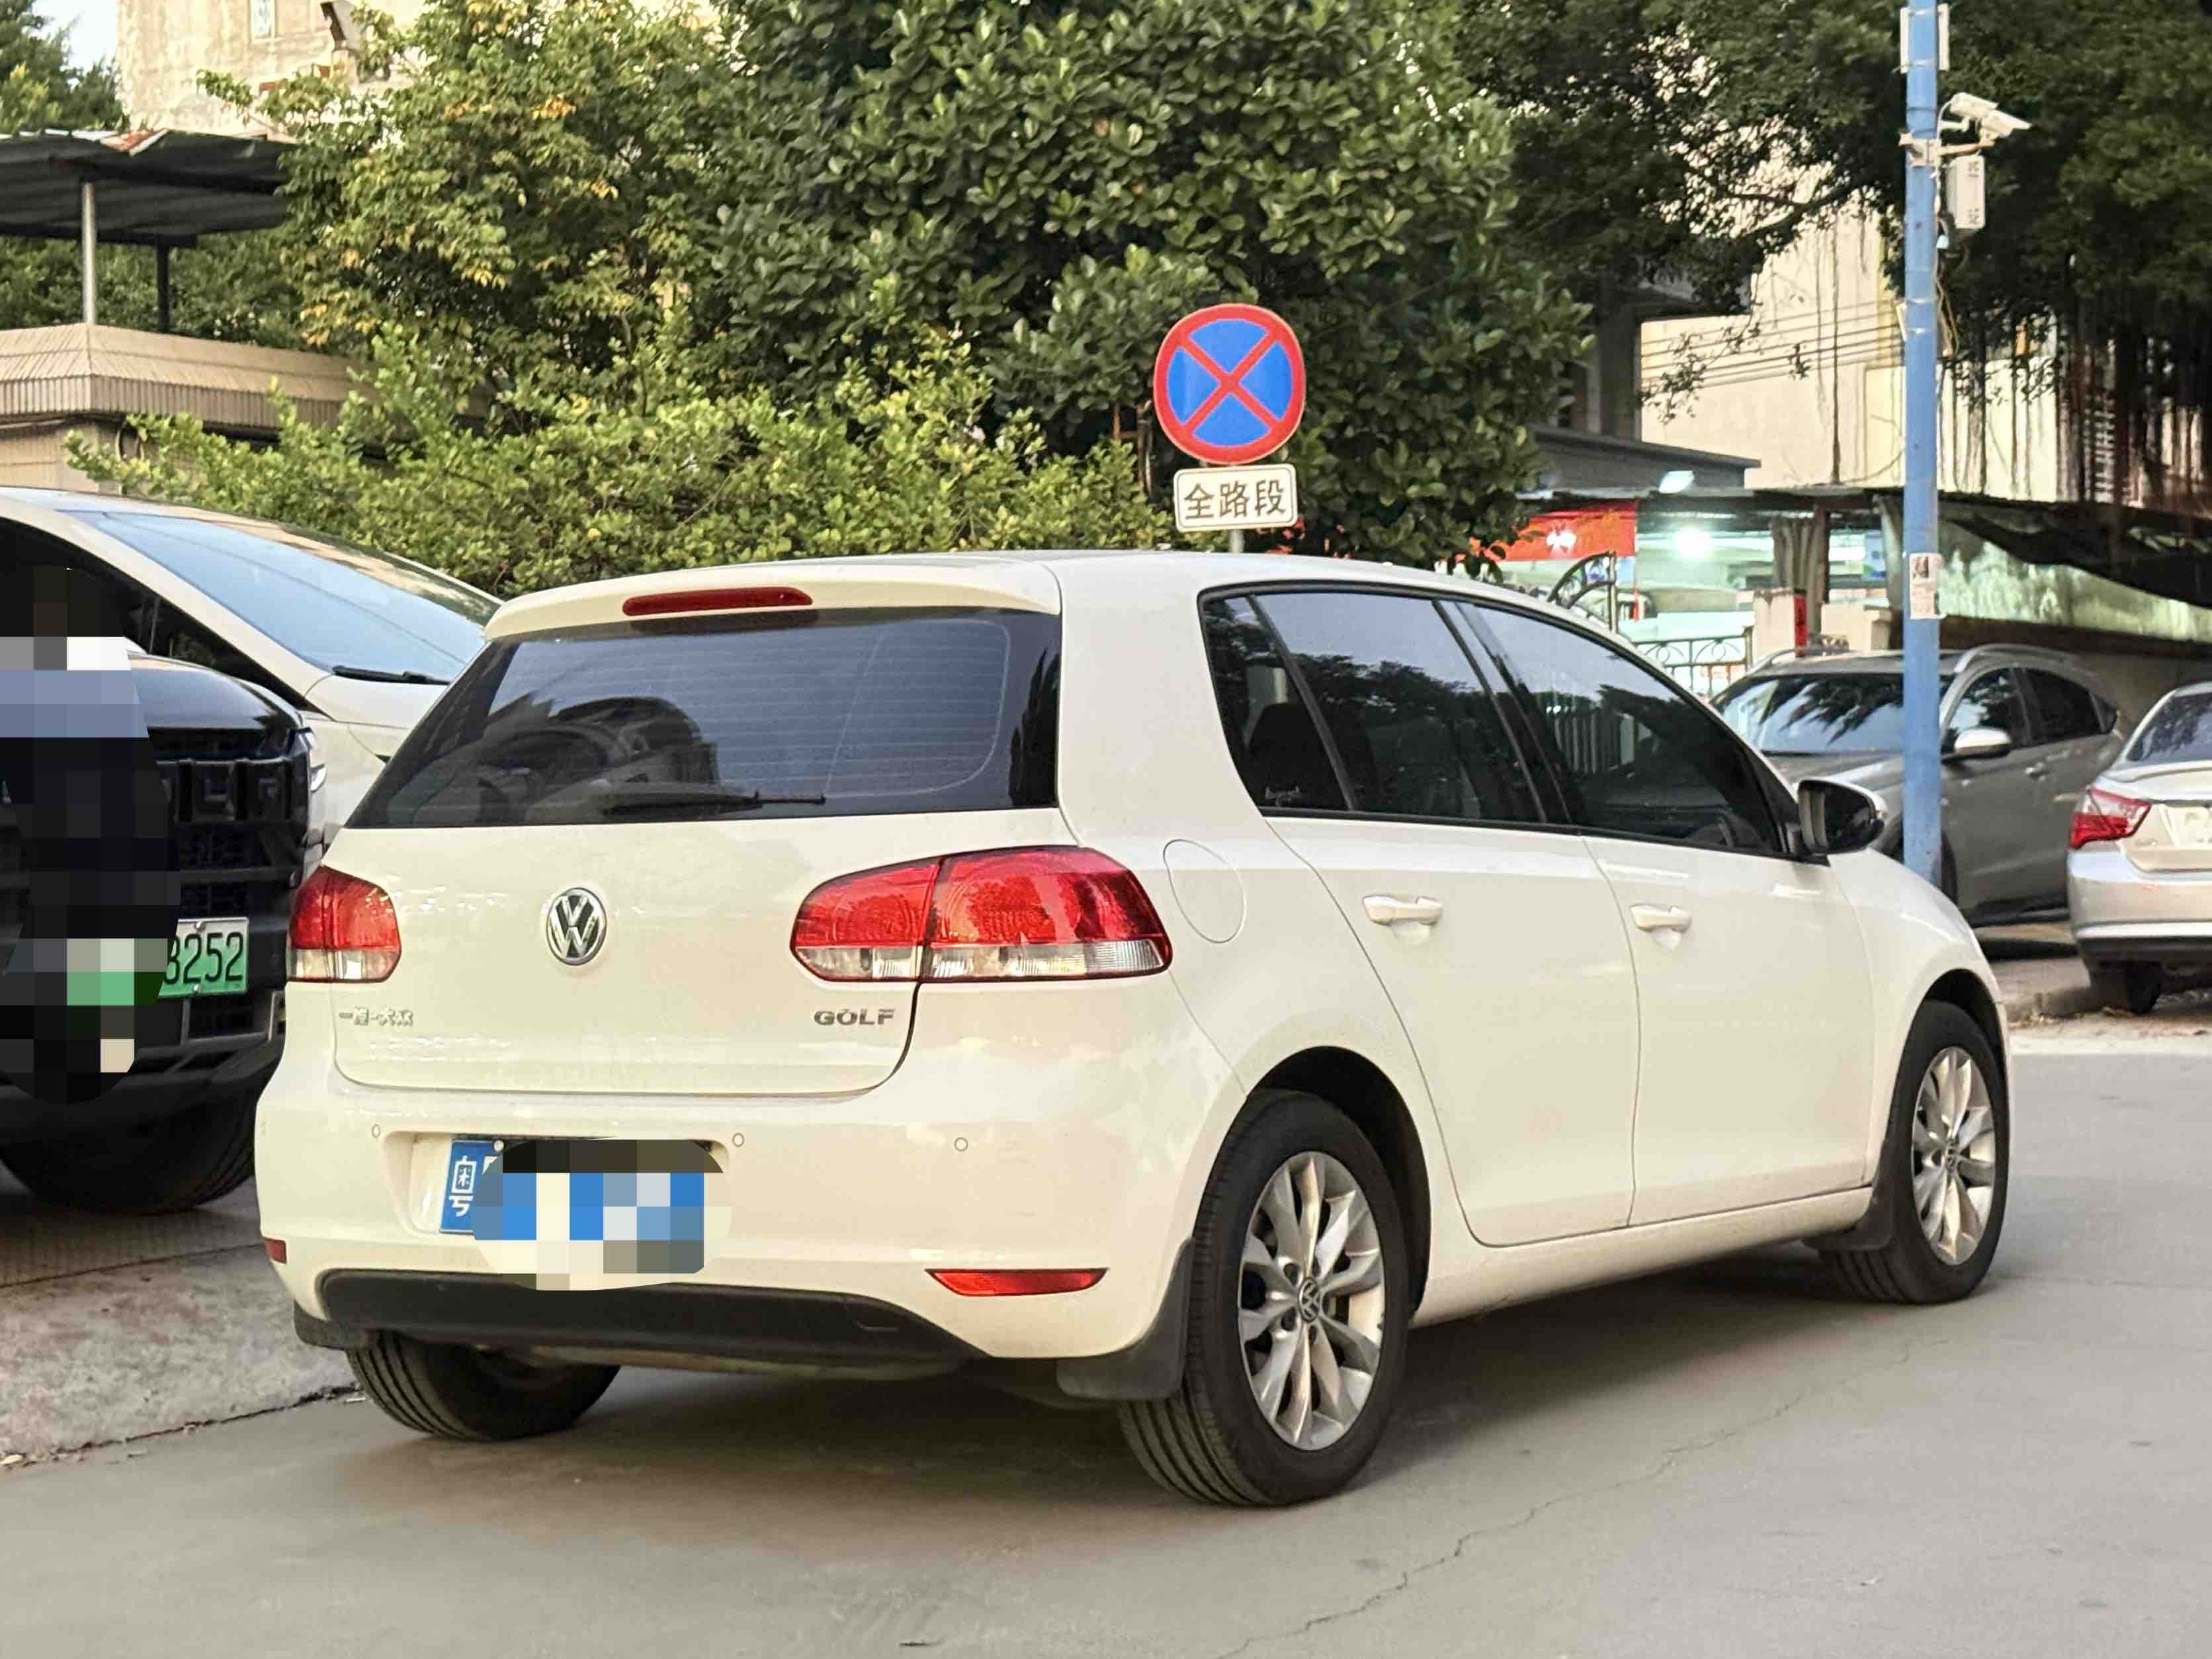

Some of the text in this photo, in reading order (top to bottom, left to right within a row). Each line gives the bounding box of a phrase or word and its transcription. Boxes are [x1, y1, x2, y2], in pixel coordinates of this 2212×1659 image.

[1183, 480, 1287, 521] 全路段
[814, 1008, 896, 1026] GOLF
